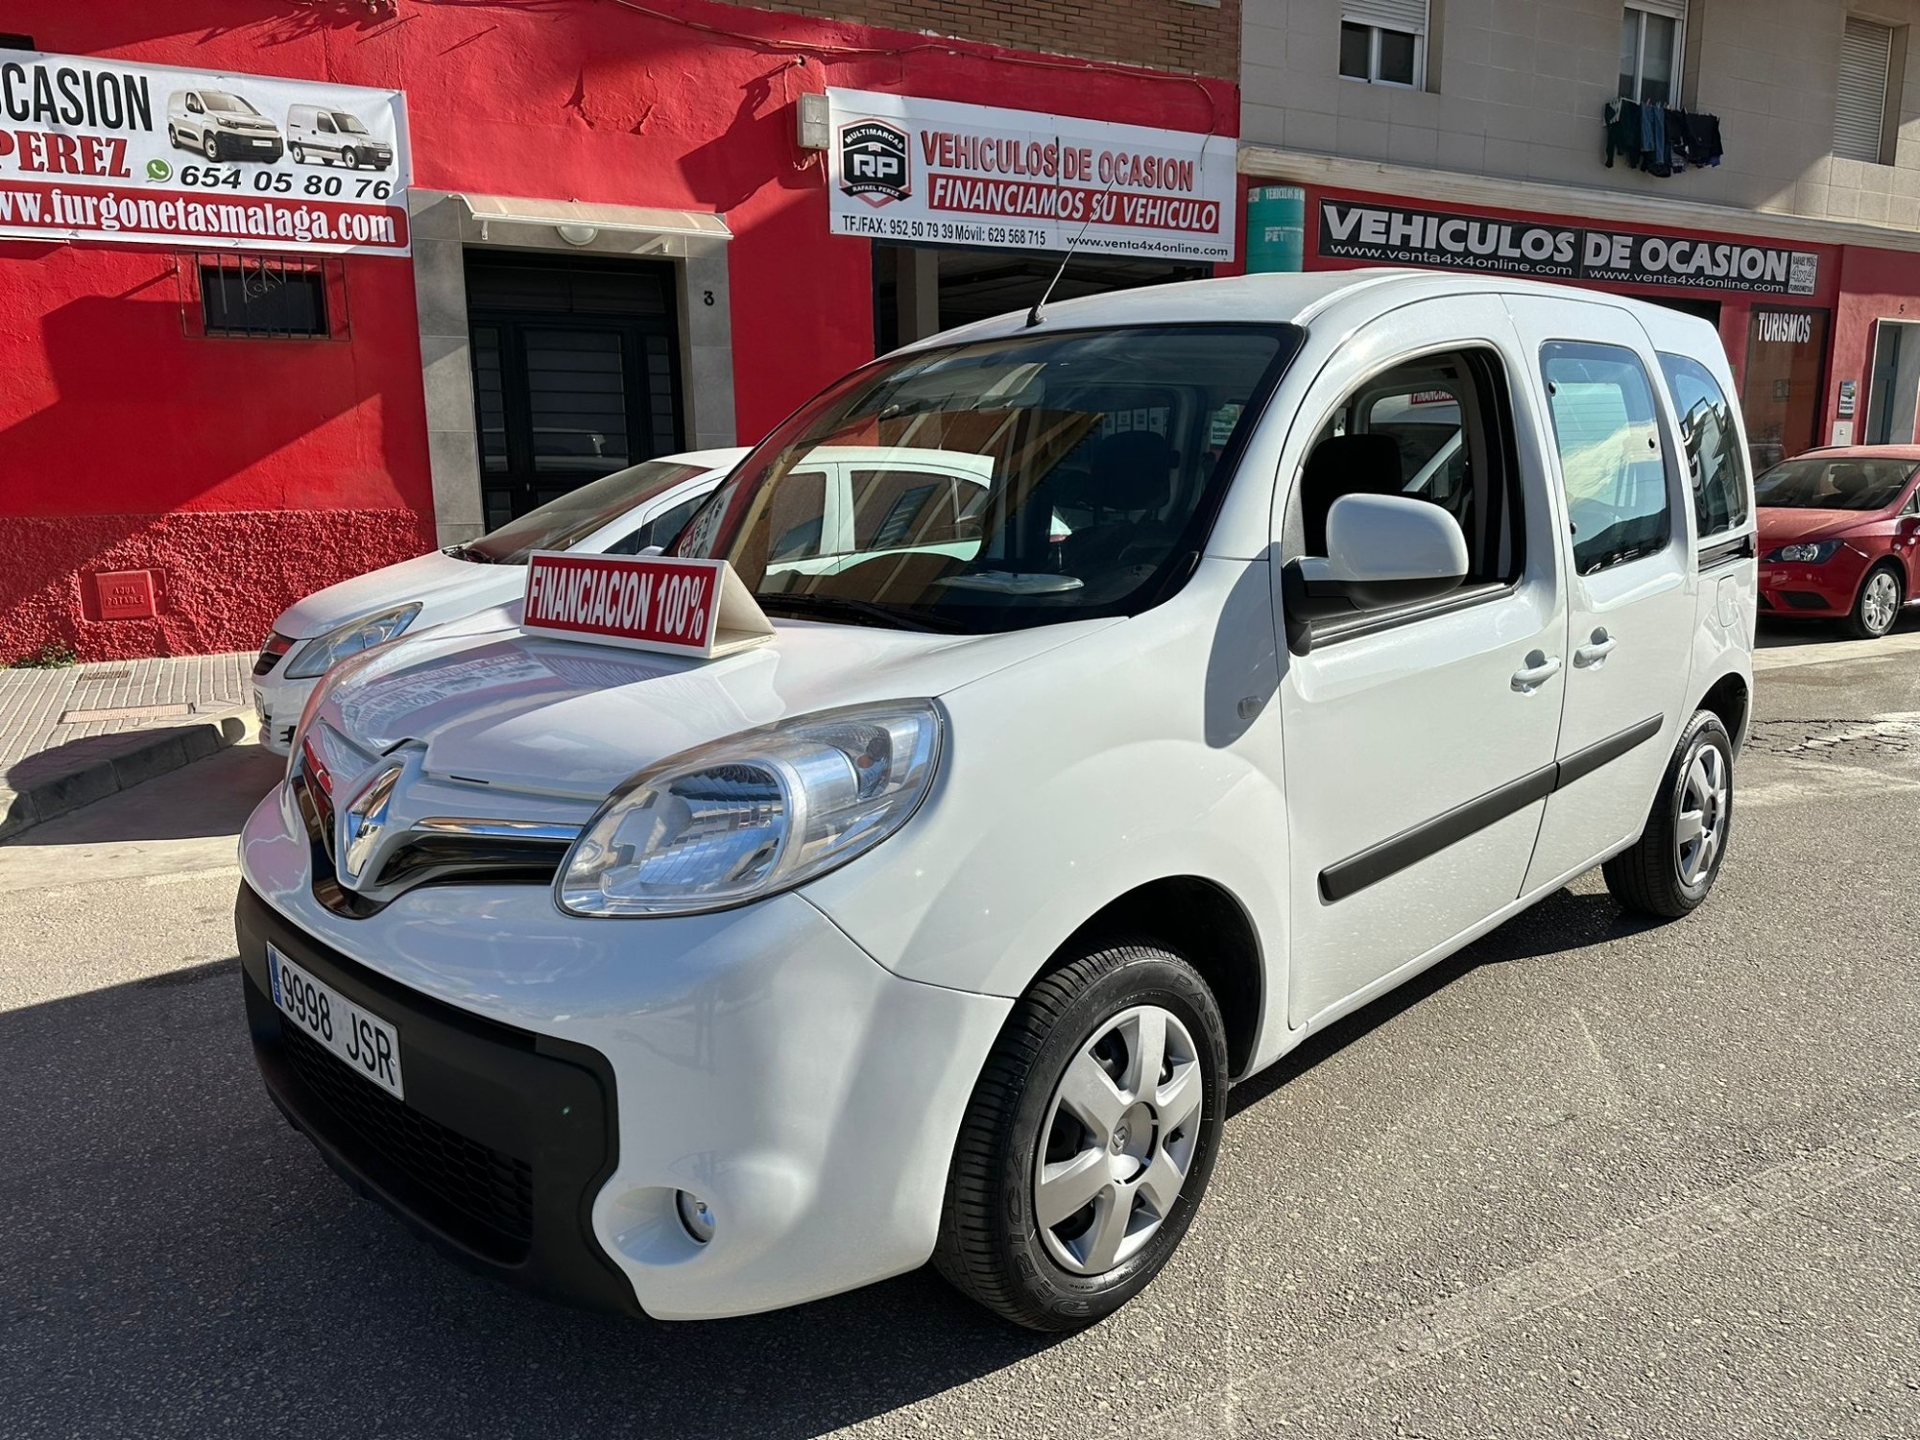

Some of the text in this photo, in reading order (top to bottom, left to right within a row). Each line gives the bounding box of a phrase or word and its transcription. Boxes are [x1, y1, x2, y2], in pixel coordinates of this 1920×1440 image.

[0, 62, 153, 132] CASION
[844, 128, 904, 150] MULTIMARCAS
[853, 153, 898, 178] RP
[920, 130, 1194, 191] VEHICULOS DE OCASION
[180, 165, 392, 200] 654 05 80 76
[852, 184, 900, 197] RAFAEL PEREZ
[933, 178, 1217, 231] FINANCIAMOS SU VEHICULO
[842, 215, 1046, 245] TF./FAX: 952 50 79 39 Móvil: 629 568 715
[1066, 235, 1228, 256] www.venta4x4online.com
[1323, 205, 1789, 282] VEHICULOS DE OCASION
[1330, 244, 1784, 293] www.venta4x4online.com www.venta4x4online.com
[703, 290, 714, 306] 3
[1758, 312, 1811, 344] TURISMOS
[527, 565, 708, 641] FINANCIACION 100%
[281, 965, 396, 1087] 9998 JSR
